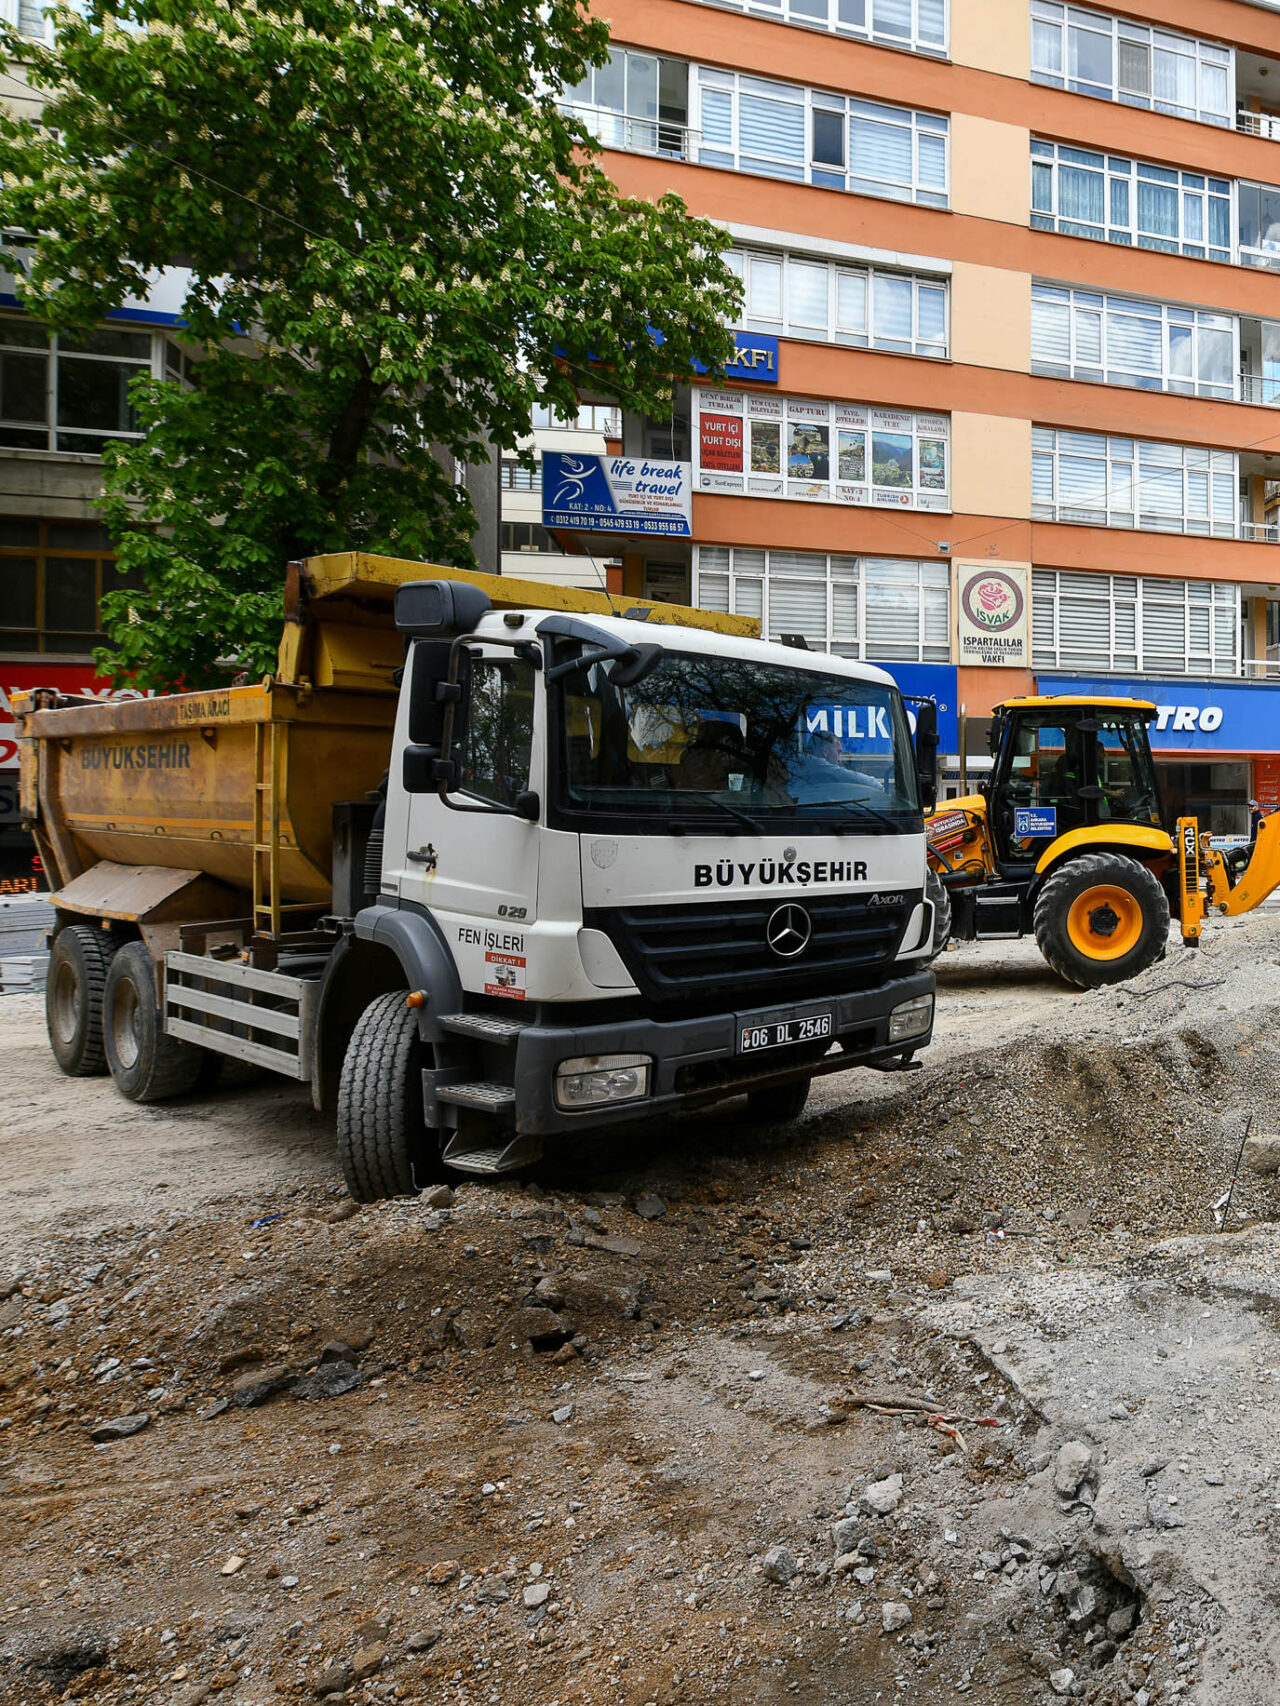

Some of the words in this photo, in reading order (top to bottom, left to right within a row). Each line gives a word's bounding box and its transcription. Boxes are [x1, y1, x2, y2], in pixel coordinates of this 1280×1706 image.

[704, 422, 726, 430] YURT
[728, 422, 738, 434] İÇİ
[702, 435, 724, 445] YURT
[725, 438, 740, 448] DIŞI
[610, 460, 634, 478] life
[640, 462, 682, 480] break
[636, 482, 682, 496] travel
[569, 503, 584, 511] KAT:
[594, 504, 607, 512] NO:
[556, 515, 569, 524] 0312
[570, 516, 579, 525] 419
[580, 516, 588, 525] 70
[588, 517, 595, 526] 19
[625, 519, 632, 528] 53
[633, 520, 639, 529] 19
[964, 636, 1022, 647] ISPARTALILAR
[982, 655, 1005, 663] VAKFI
[81, 737, 190, 774] BÜYÜKŞEHİR
[1185, 828, 1195, 854] 4CX
[459, 928, 481, 945] FEN
[484, 929, 524, 952] İŞLERİ
[491, 955, 515, 965] DİKKAT
[752, 1028, 768, 1047] 06
[777, 1026, 792, 1043] DL
[799, 1017, 828, 1039] 2546
